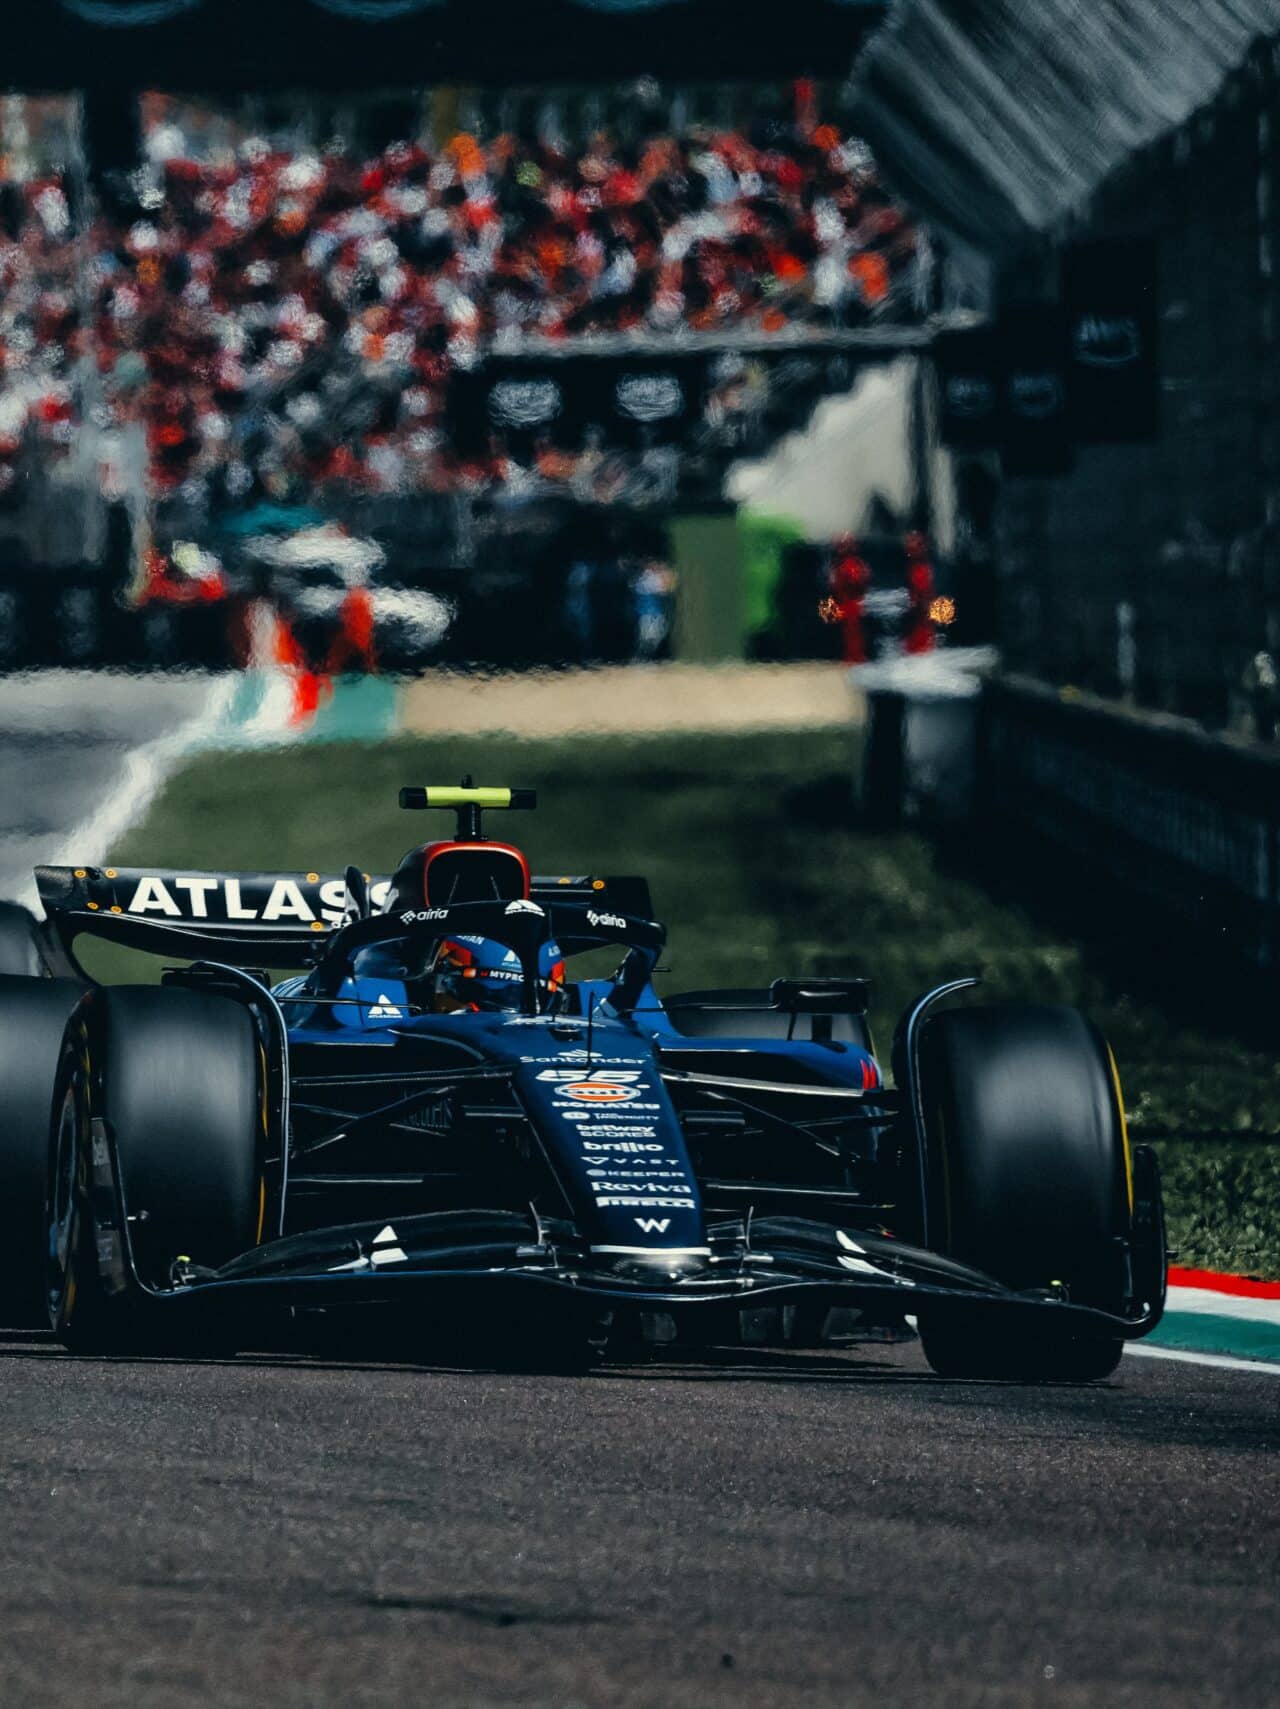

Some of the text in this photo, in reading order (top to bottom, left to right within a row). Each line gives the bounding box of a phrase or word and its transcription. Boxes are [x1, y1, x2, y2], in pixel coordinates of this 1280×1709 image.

[520, 1056, 646, 1065] Santander
[535, 1069, 642, 1083] 55
[583, 1142, 664, 1152] brillio
[591, 1181, 692, 1194] Reviva
